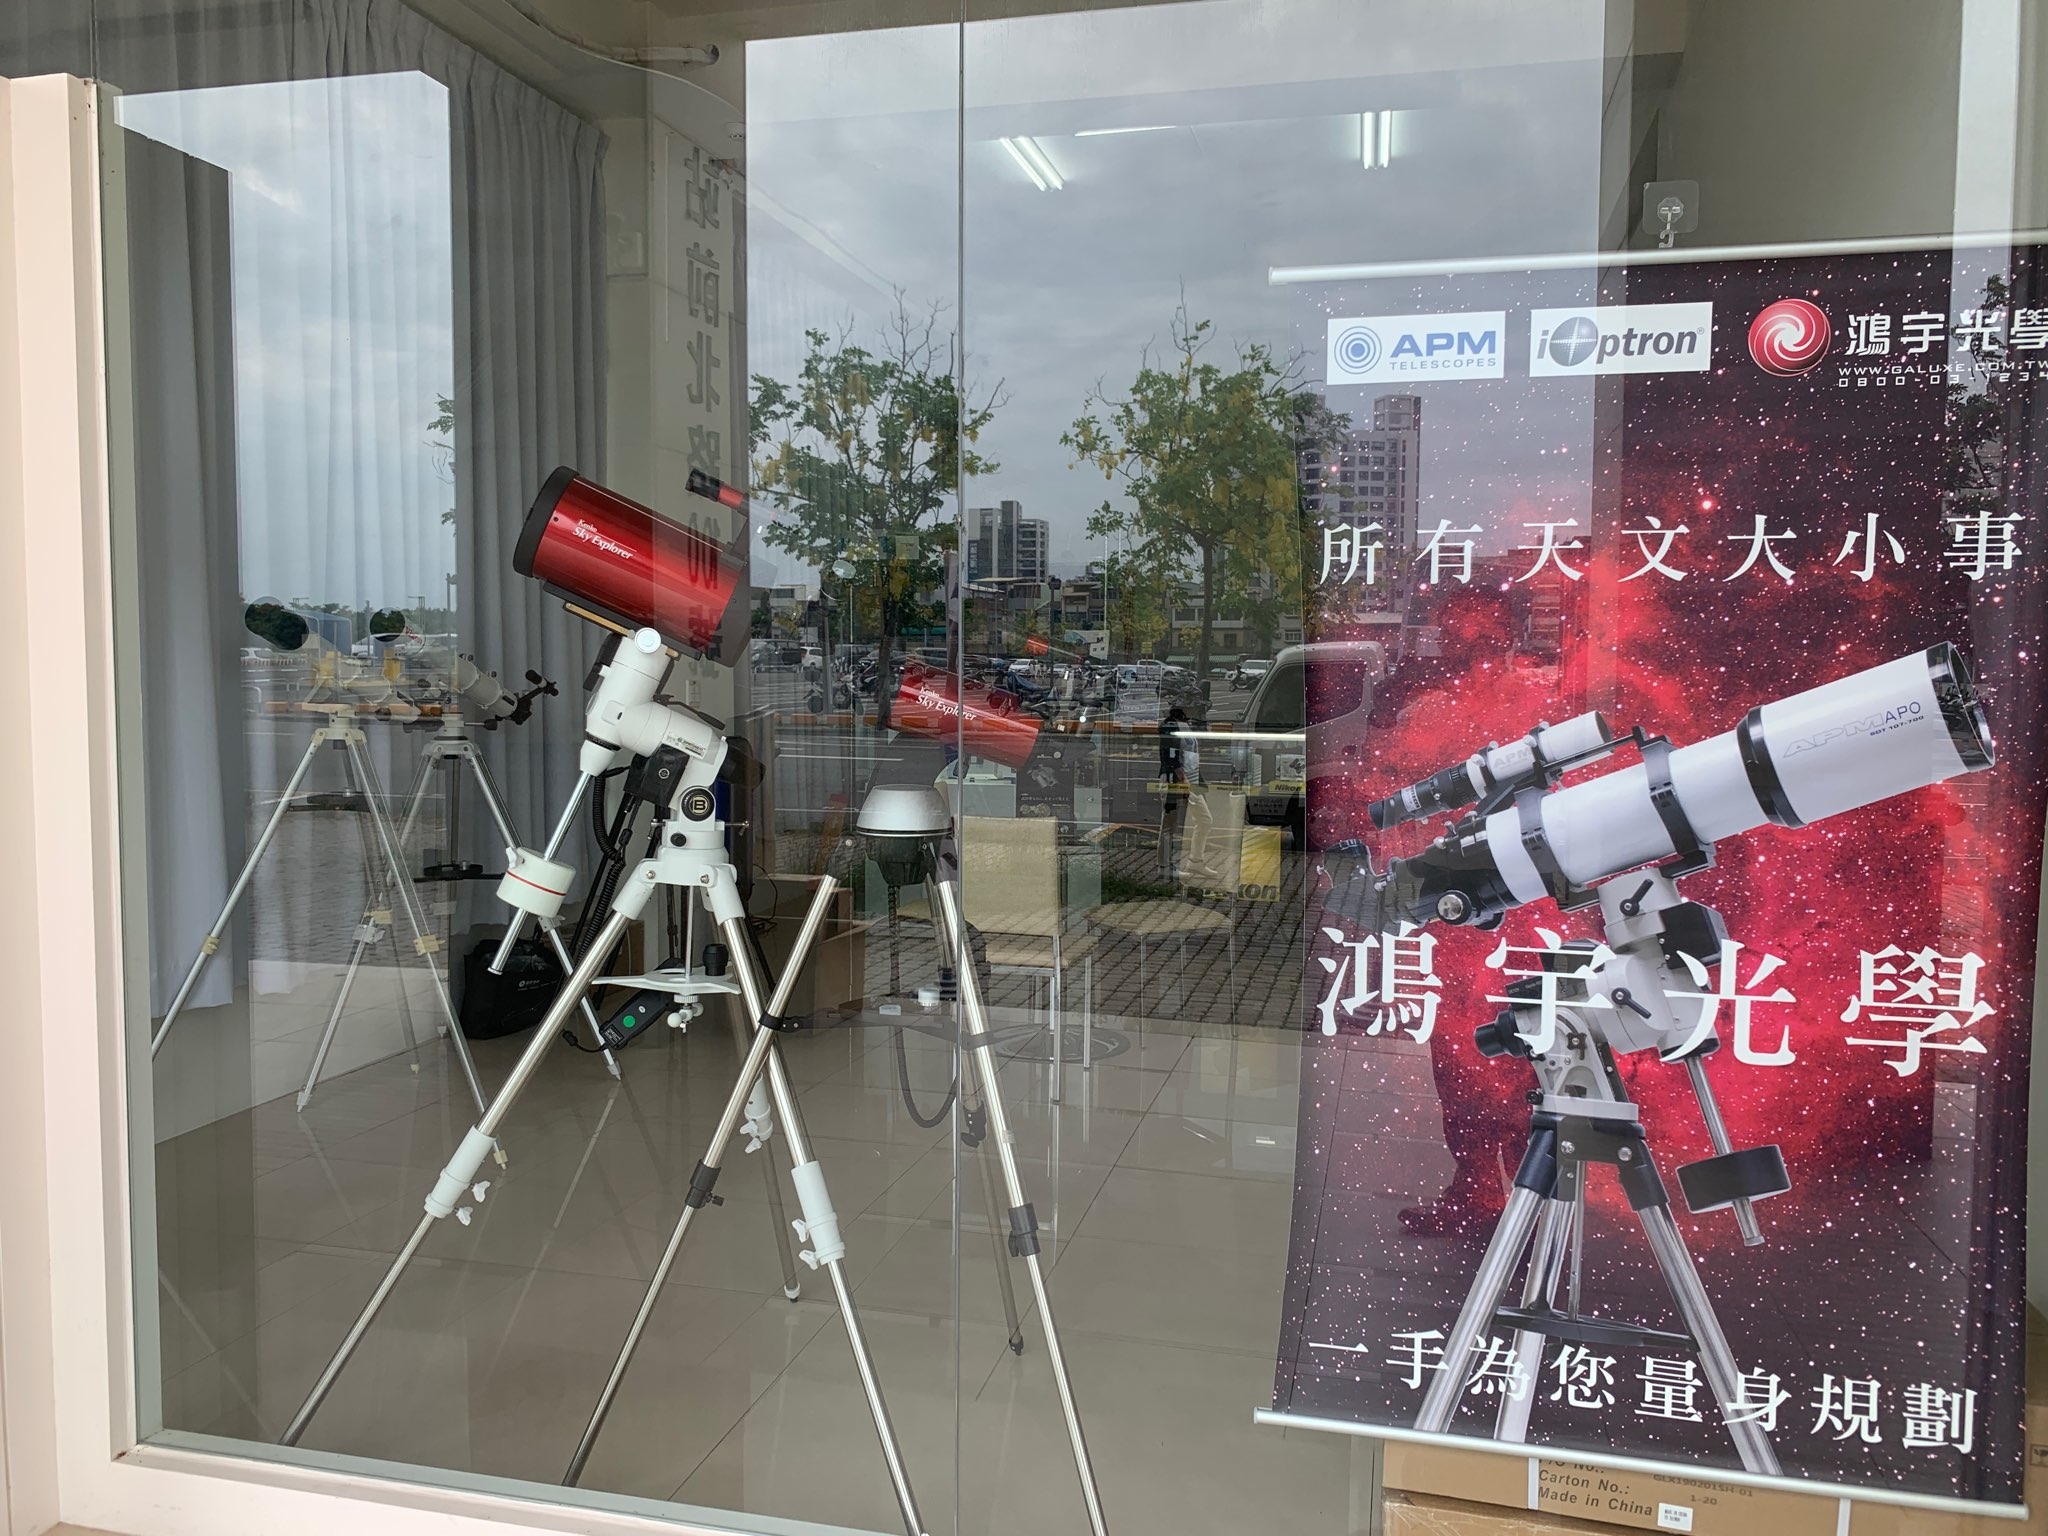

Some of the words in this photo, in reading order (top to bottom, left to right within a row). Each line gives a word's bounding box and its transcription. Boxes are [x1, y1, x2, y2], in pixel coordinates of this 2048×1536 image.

[1390, 331, 1497, 358] APM
[1844, 308, 2048, 357] 鴻宇光學
[1389, 358, 1497, 372] TELESCOPES
[572, 527, 592, 543] Sky
[591, 535, 634, 559] Explorer
[1319, 510, 2025, 586] 所有天文大小事
[915, 694, 936, 710] Sky
[1274, 784, 1302, 792] Nikon
[1316, 921, 1997, 1077] 鴻宇光學
[1308, 1330, 1978, 1454] 一手為您量身規劃
[1538, 1469, 1590, 1489] Carton
[1599, 1479, 1630, 1495] No.:
[1538, 1486, 1577, 1504] Made
[1585, 1494, 1599, 1508] in
[1608, 1498, 1653, 1517] China
